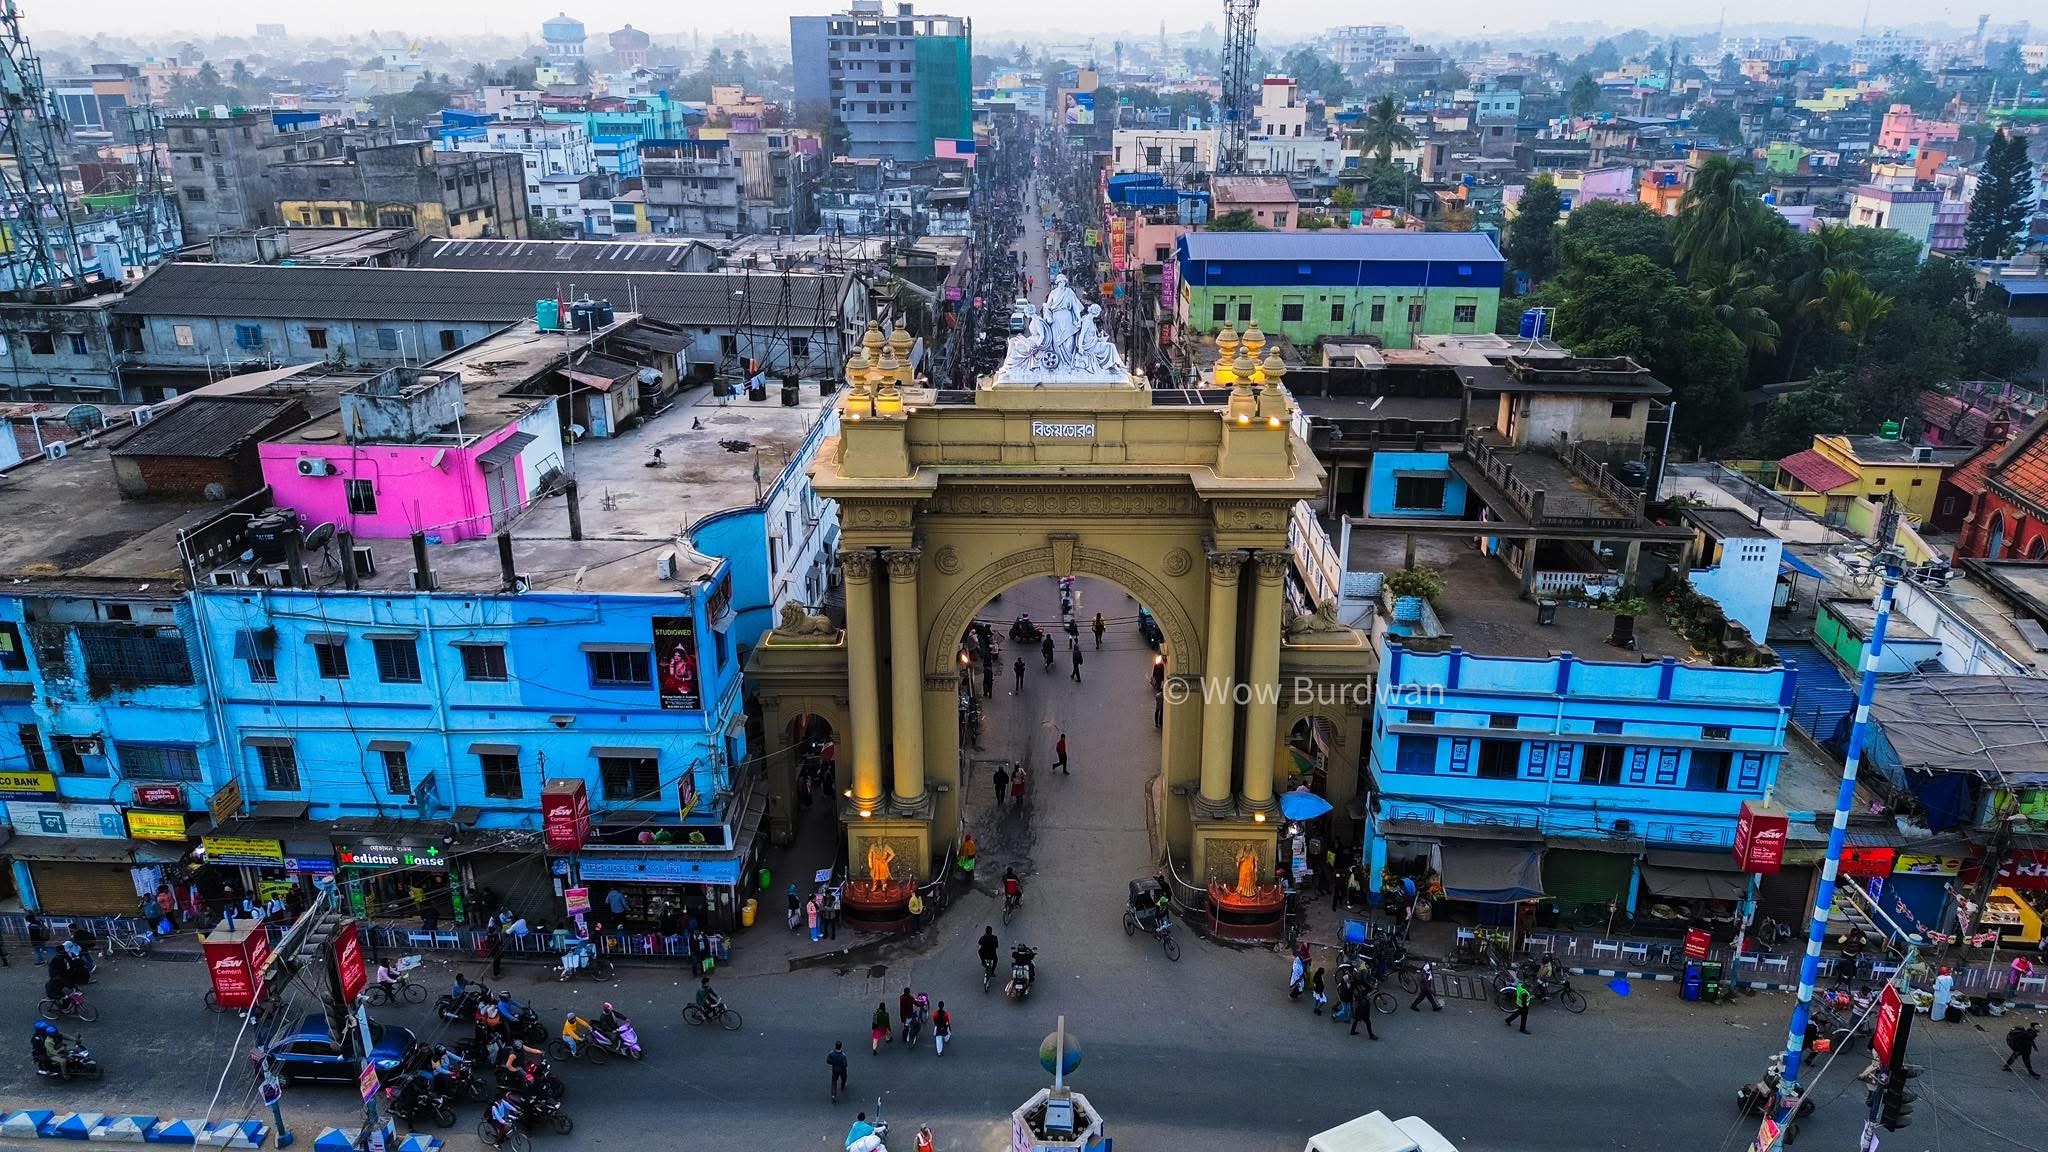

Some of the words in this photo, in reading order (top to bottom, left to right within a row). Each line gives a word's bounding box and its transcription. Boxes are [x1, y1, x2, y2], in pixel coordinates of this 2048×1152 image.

[1032, 421, 1095, 438] বিজয়তোরণ
[14, 777, 40, 786] BANK
[548, 806, 573, 817] JSW
[1753, 829, 1783, 838] JSW
[341, 852, 398, 864] Medicine
[404, 854, 444, 866] House
[212, 956, 243, 970] JSW
